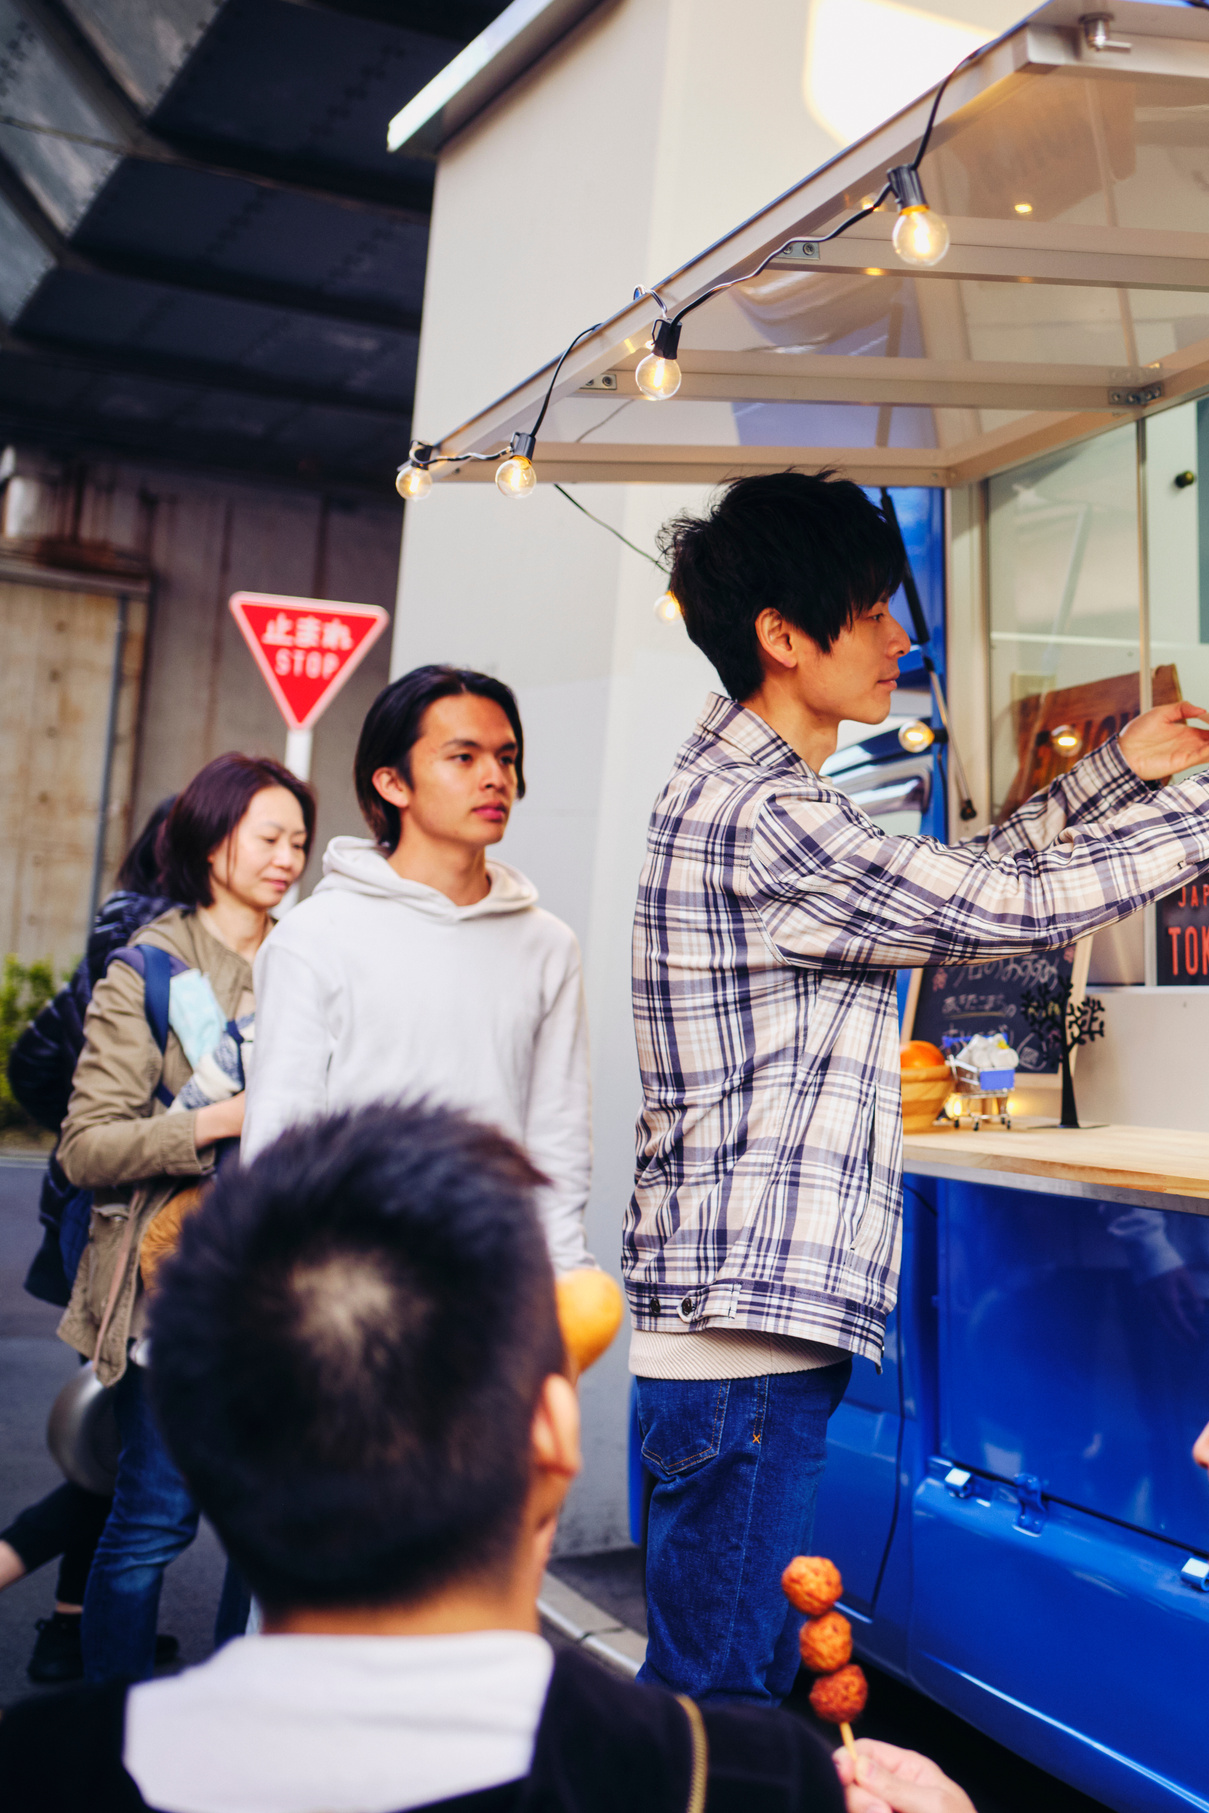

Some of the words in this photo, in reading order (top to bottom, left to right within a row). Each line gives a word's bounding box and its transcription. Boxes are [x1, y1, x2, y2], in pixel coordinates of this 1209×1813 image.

[261, 612, 354, 651] 止まれ
[274, 648, 340, 680] STOP
